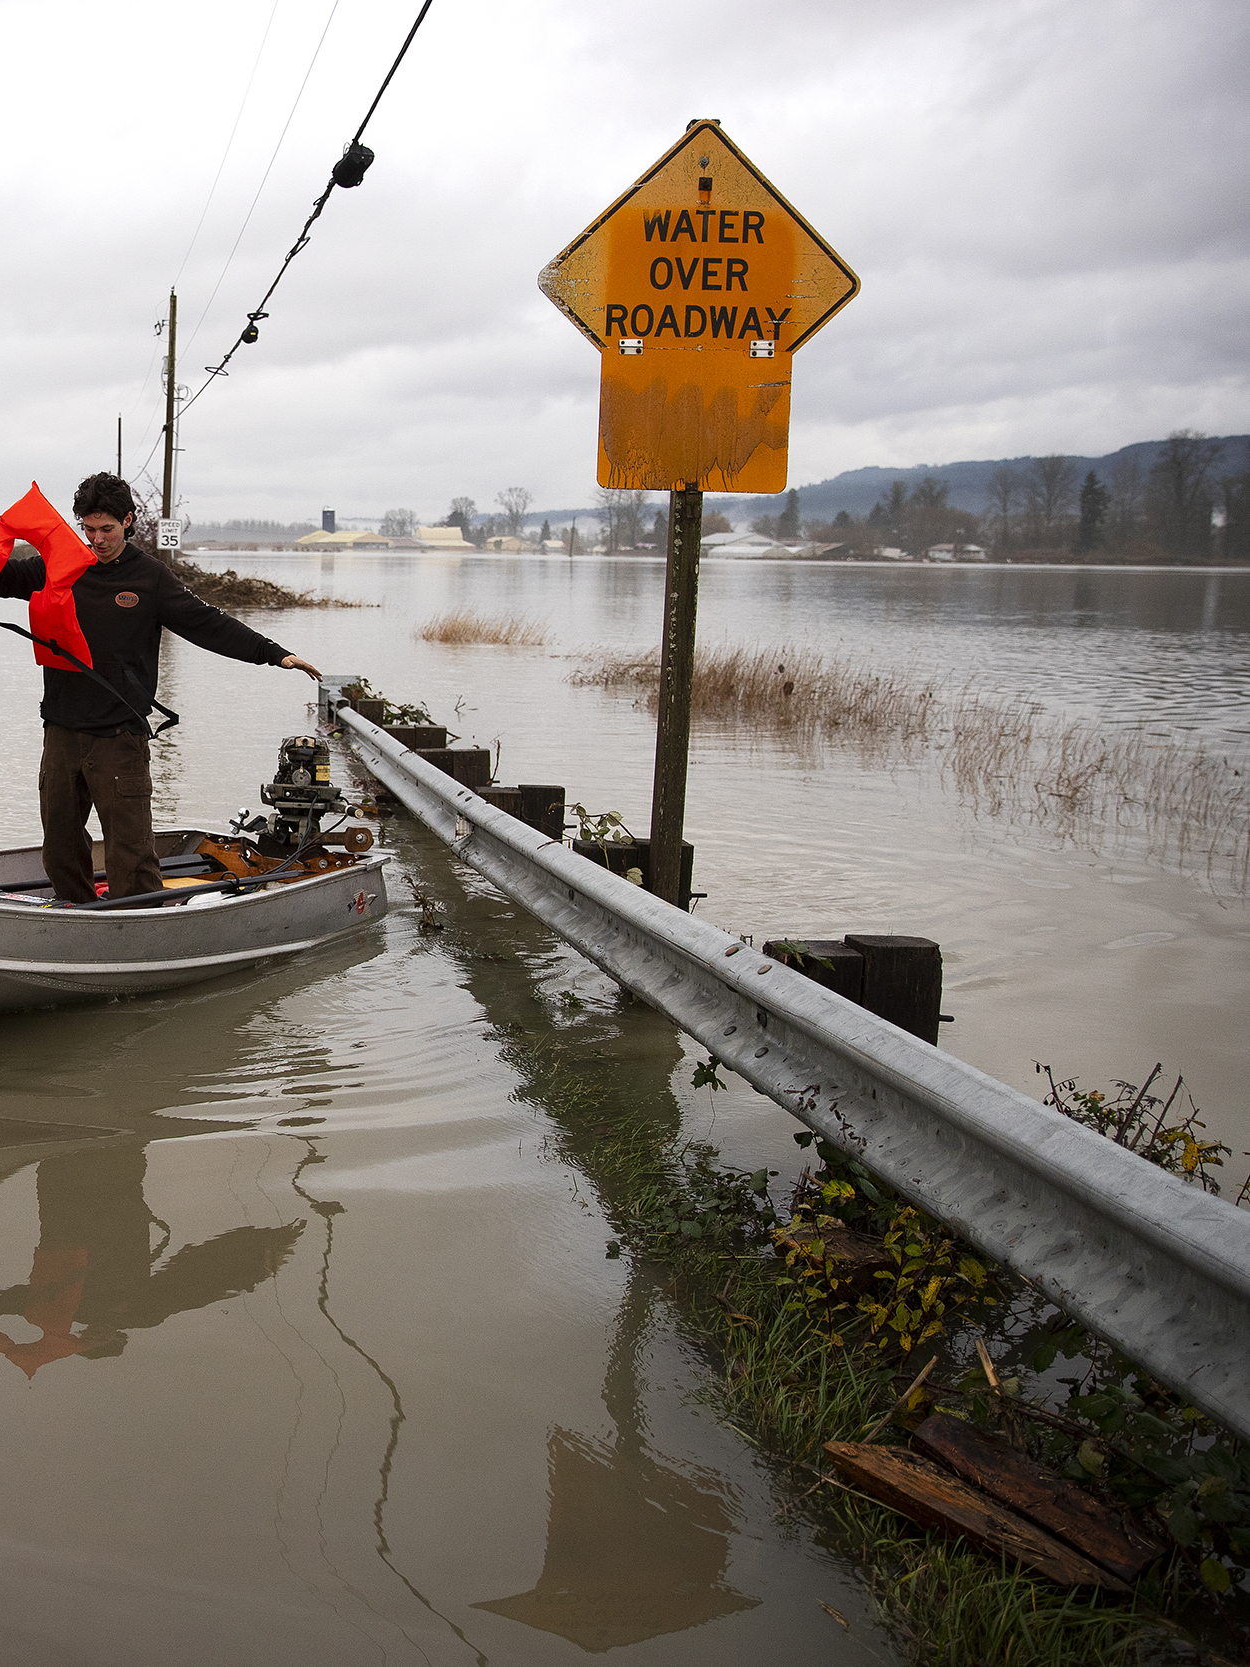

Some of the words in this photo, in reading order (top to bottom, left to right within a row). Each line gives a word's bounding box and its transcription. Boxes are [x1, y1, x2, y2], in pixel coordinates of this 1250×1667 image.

[643, 208, 765, 244] WATER
[650, 256, 749, 292] OVER
[605, 303, 792, 341] ROADWAY
[161, 535, 178, 546] 35
